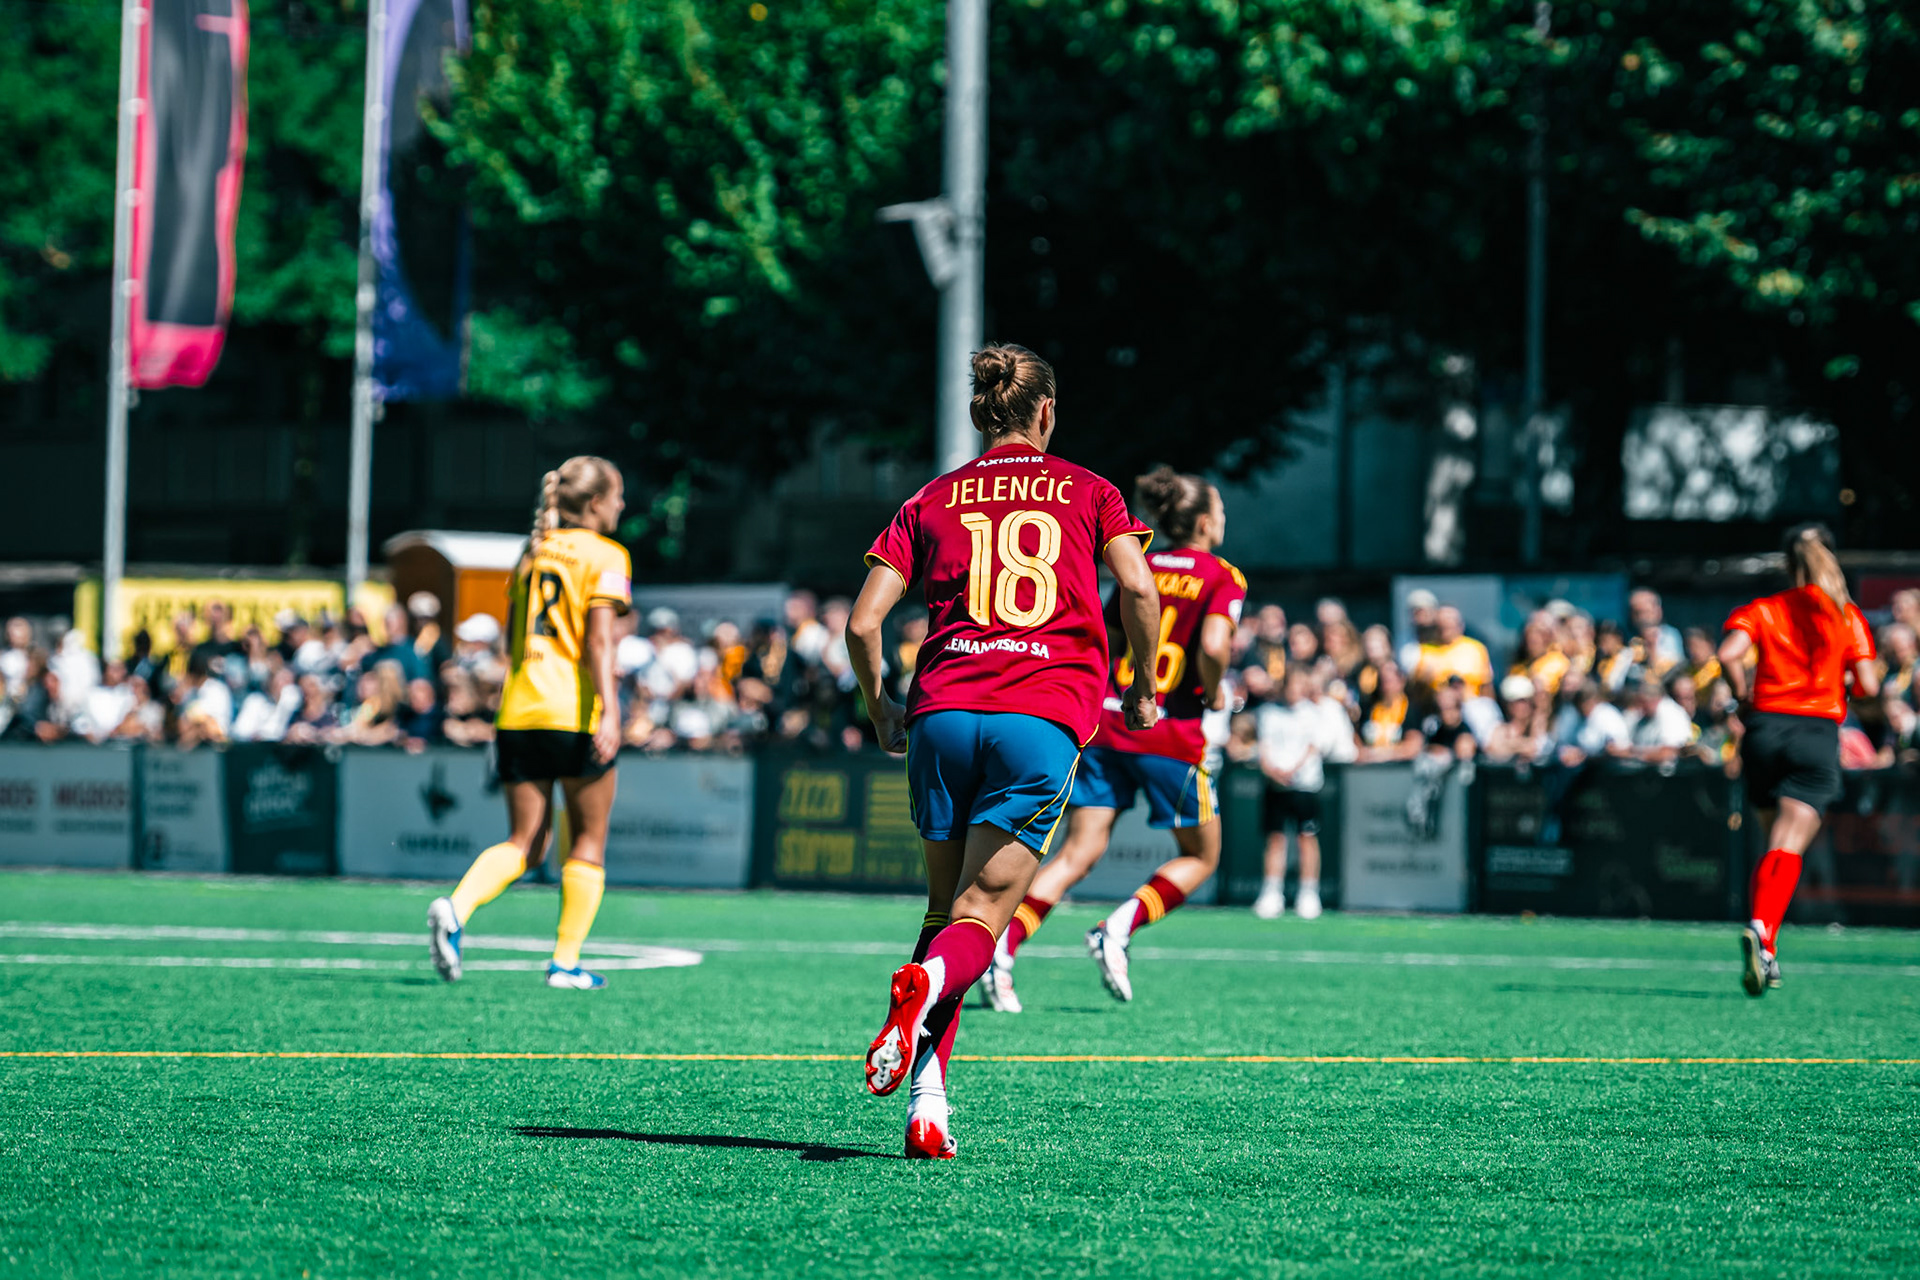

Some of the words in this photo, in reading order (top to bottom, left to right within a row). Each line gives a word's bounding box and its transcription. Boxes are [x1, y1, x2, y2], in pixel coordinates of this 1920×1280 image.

[945, 469, 1073, 508] JELENČIĆ
[960, 510, 1062, 628] 18
[1030, 642, 1049, 659] SA
